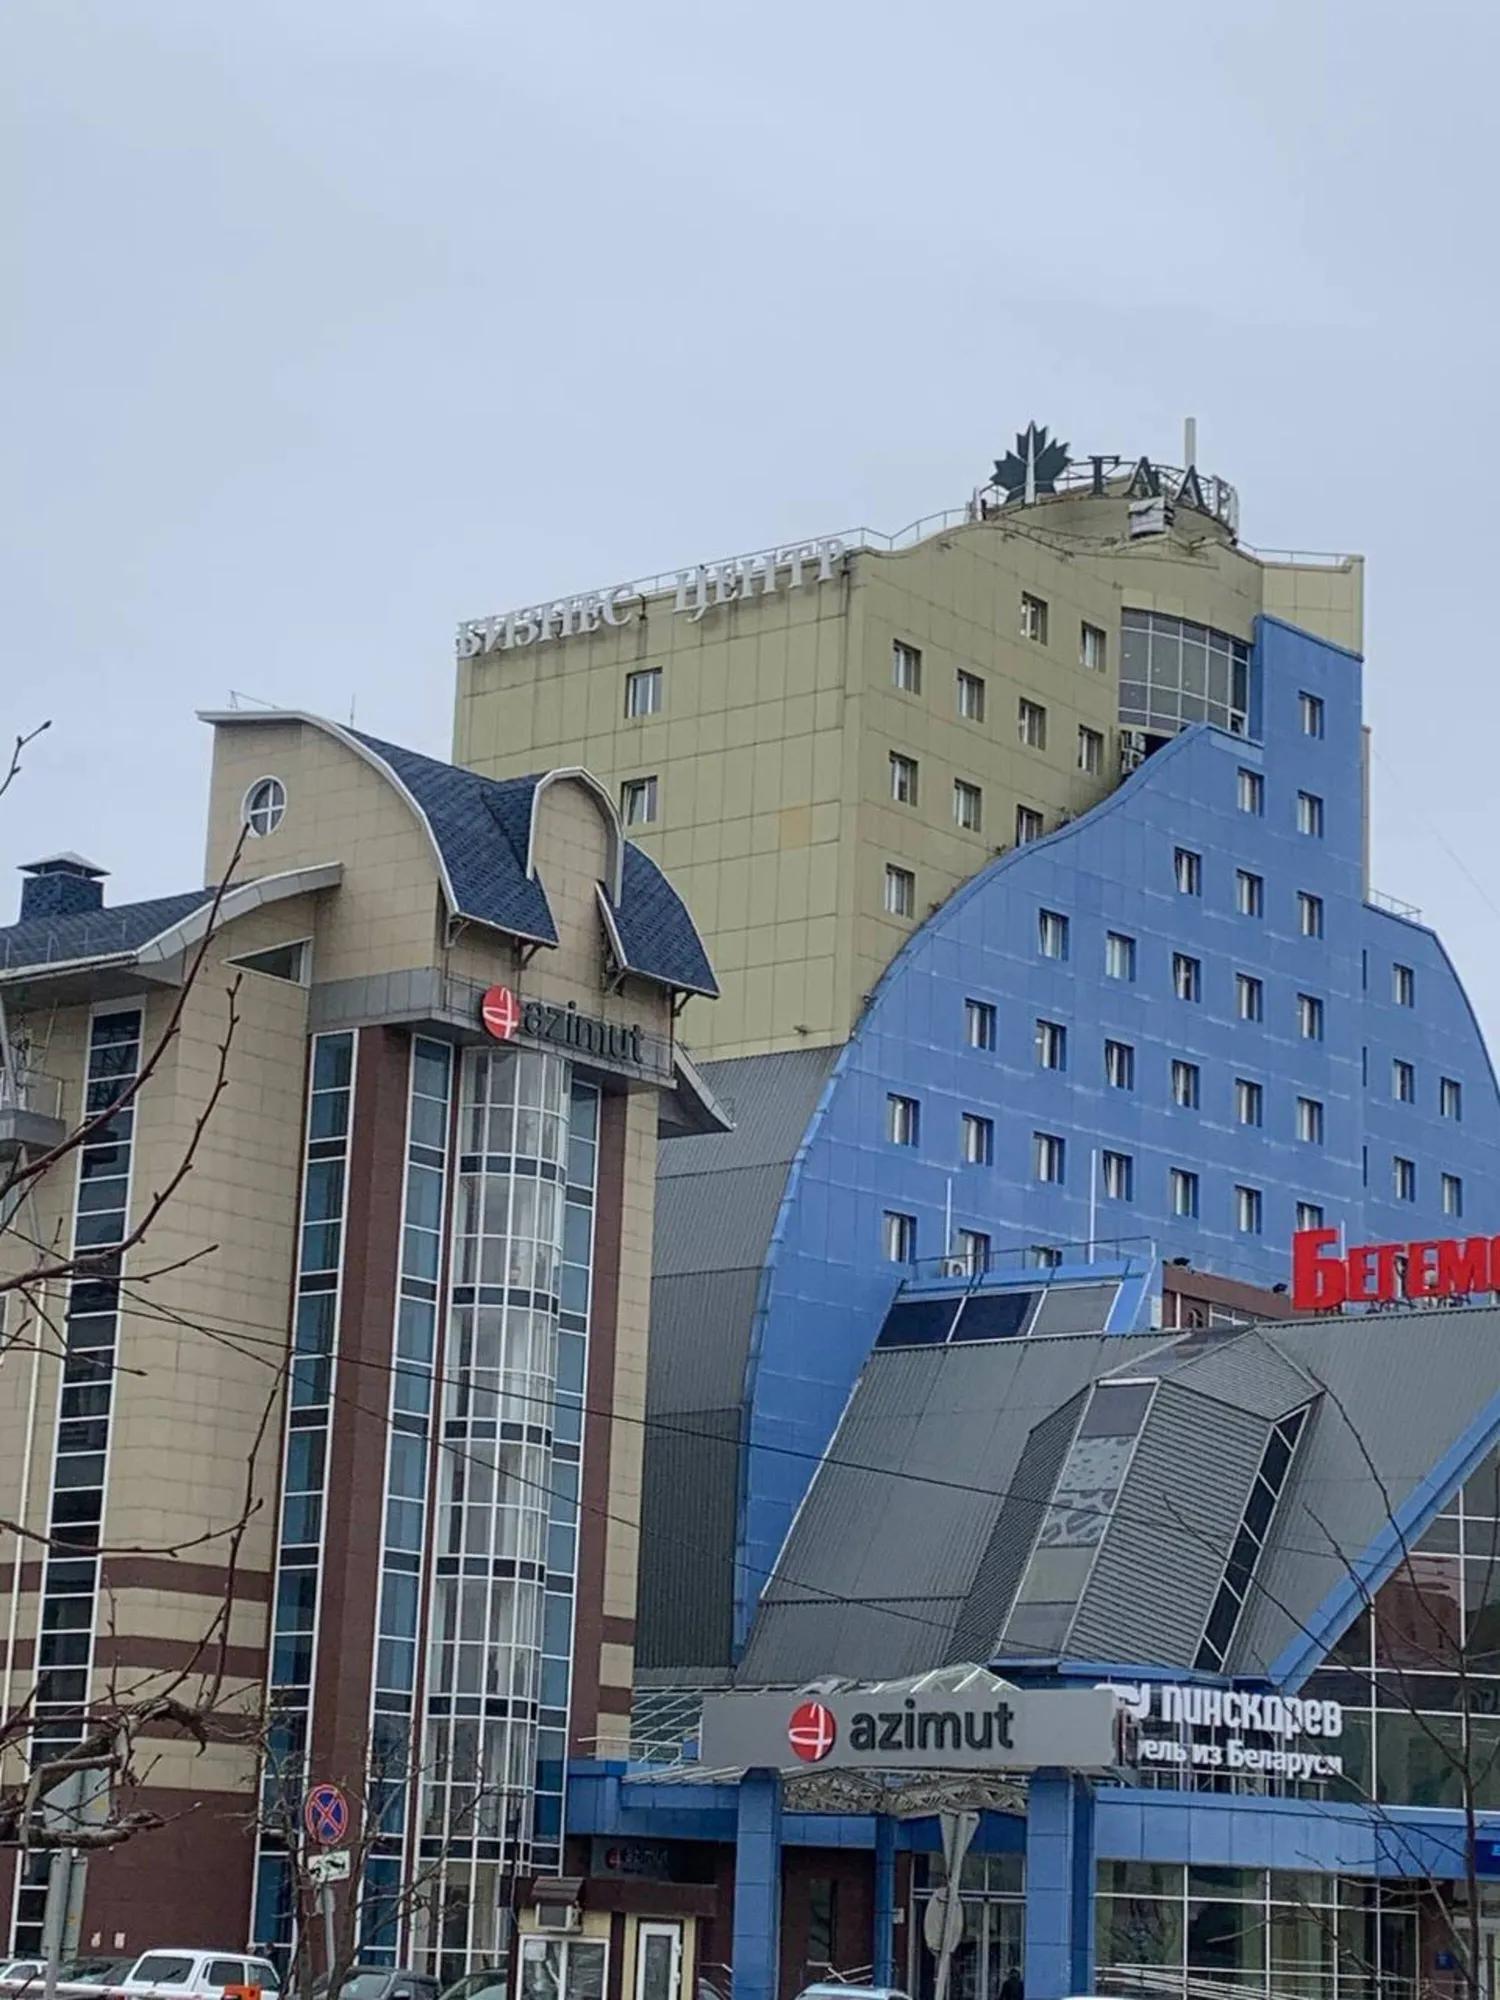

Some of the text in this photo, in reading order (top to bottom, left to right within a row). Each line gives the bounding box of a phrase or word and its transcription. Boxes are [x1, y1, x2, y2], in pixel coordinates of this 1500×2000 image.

[456, 538, 847, 659] БИЗНЕС ЦЕНТР
[525, 1001, 645, 1065] azimut
[1293, 1228, 1500, 1311] БЕГЕМ
[849, 1699, 1014, 1750] azimut
[1192, 1743, 1223, 1765] из
[1227, 1739, 1342, 1780] Беларуси
